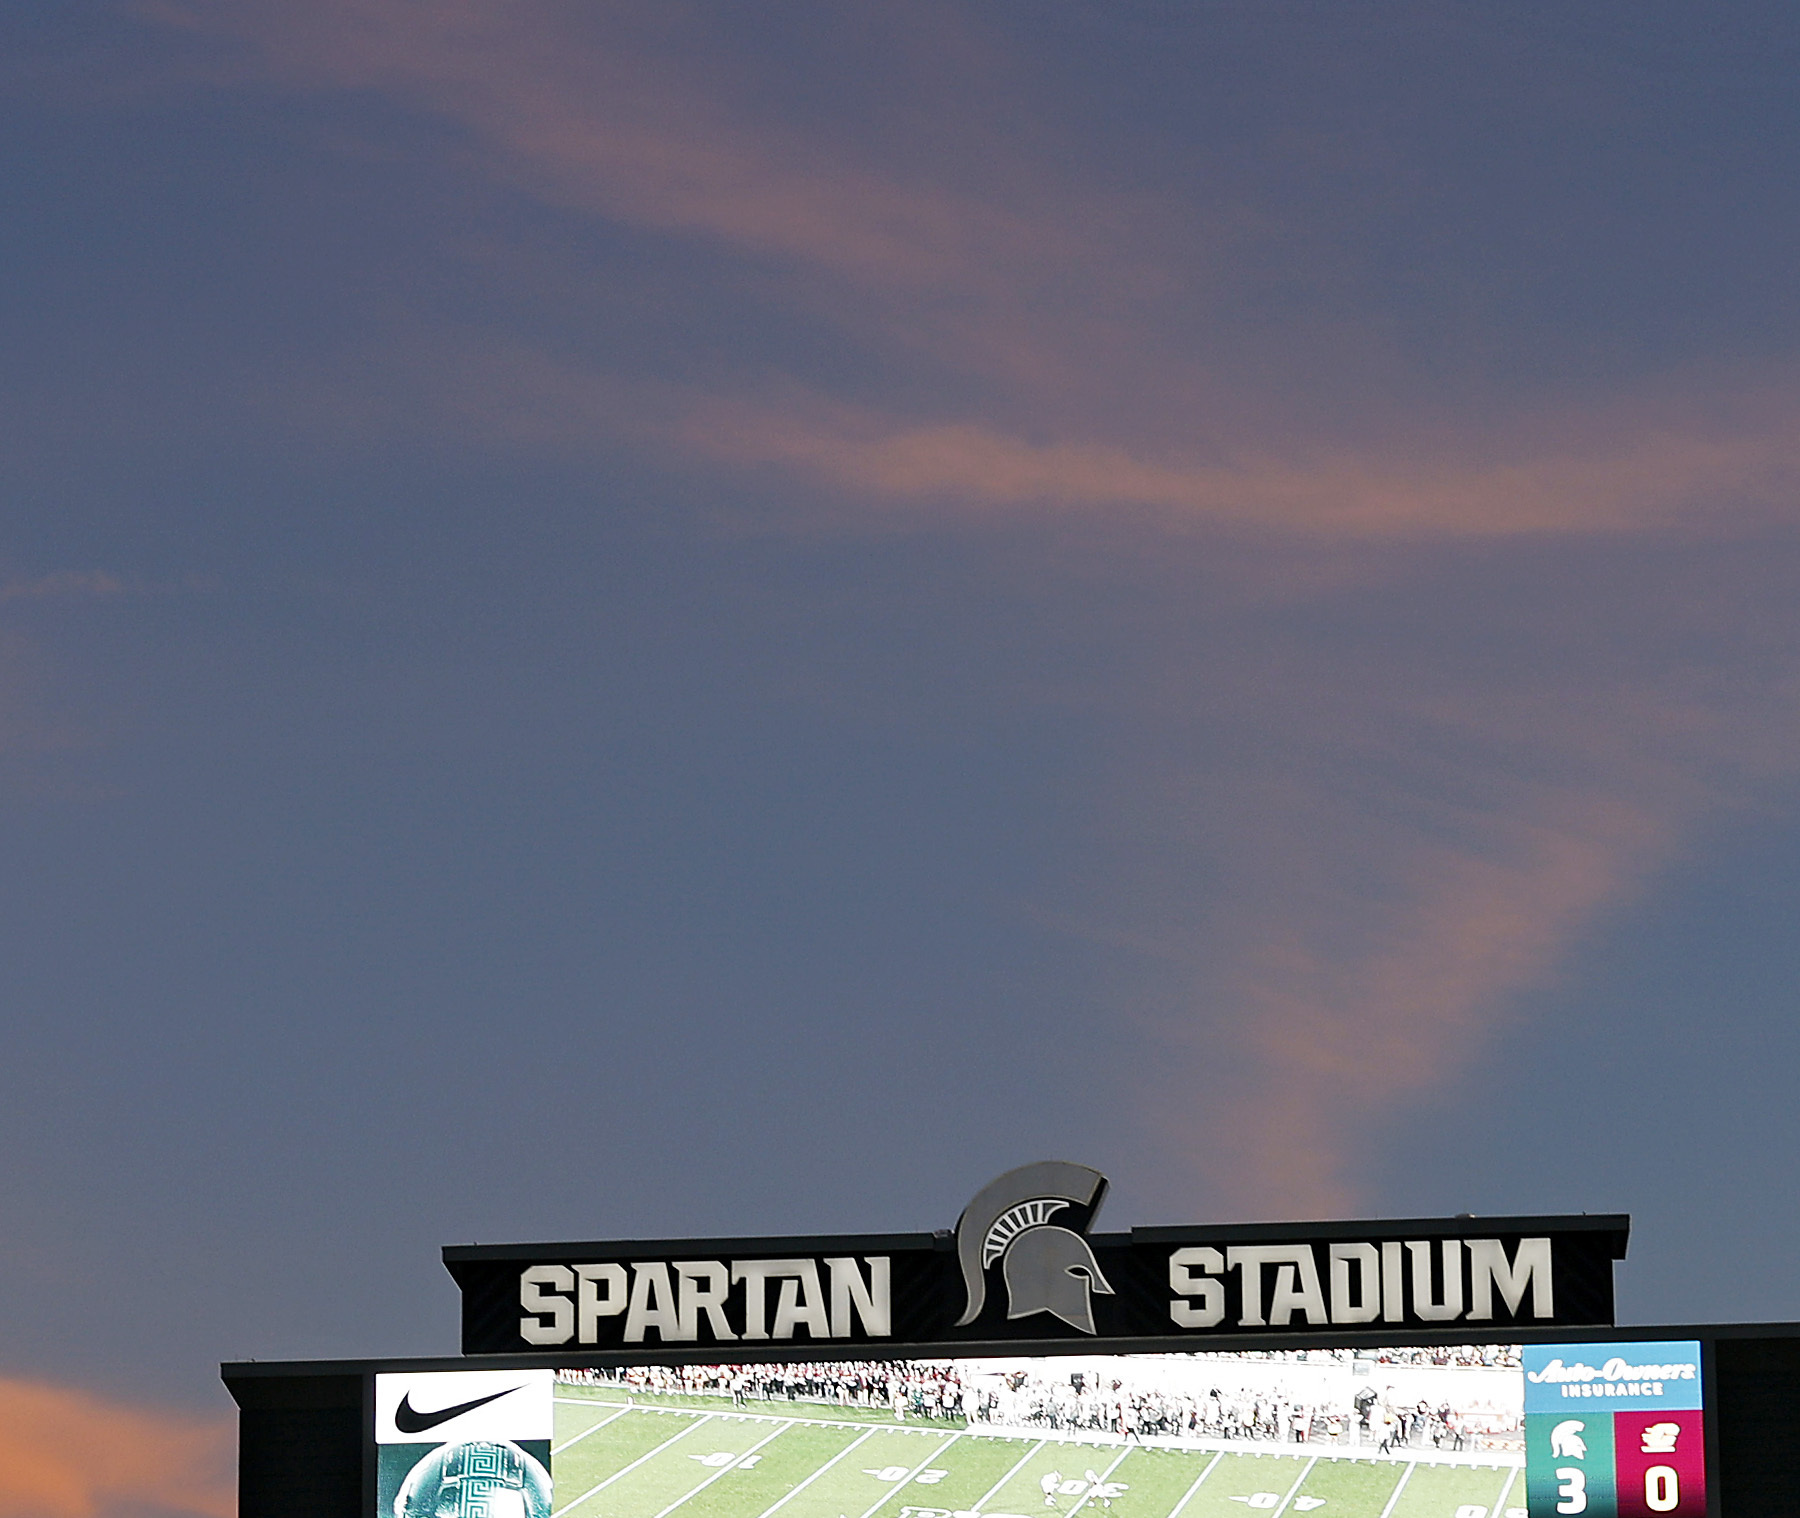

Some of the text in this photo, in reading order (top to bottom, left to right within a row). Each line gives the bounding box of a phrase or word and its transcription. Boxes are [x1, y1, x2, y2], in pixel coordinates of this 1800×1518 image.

[519, 1237, 1555, 1345] SPARTAN STADIUM
[1528, 1358, 1696, 1383] Auto-Owners
[1561, 1382, 1663, 1397] INSURANCE
[1555, 1466, 1679, 1514] 3 0
